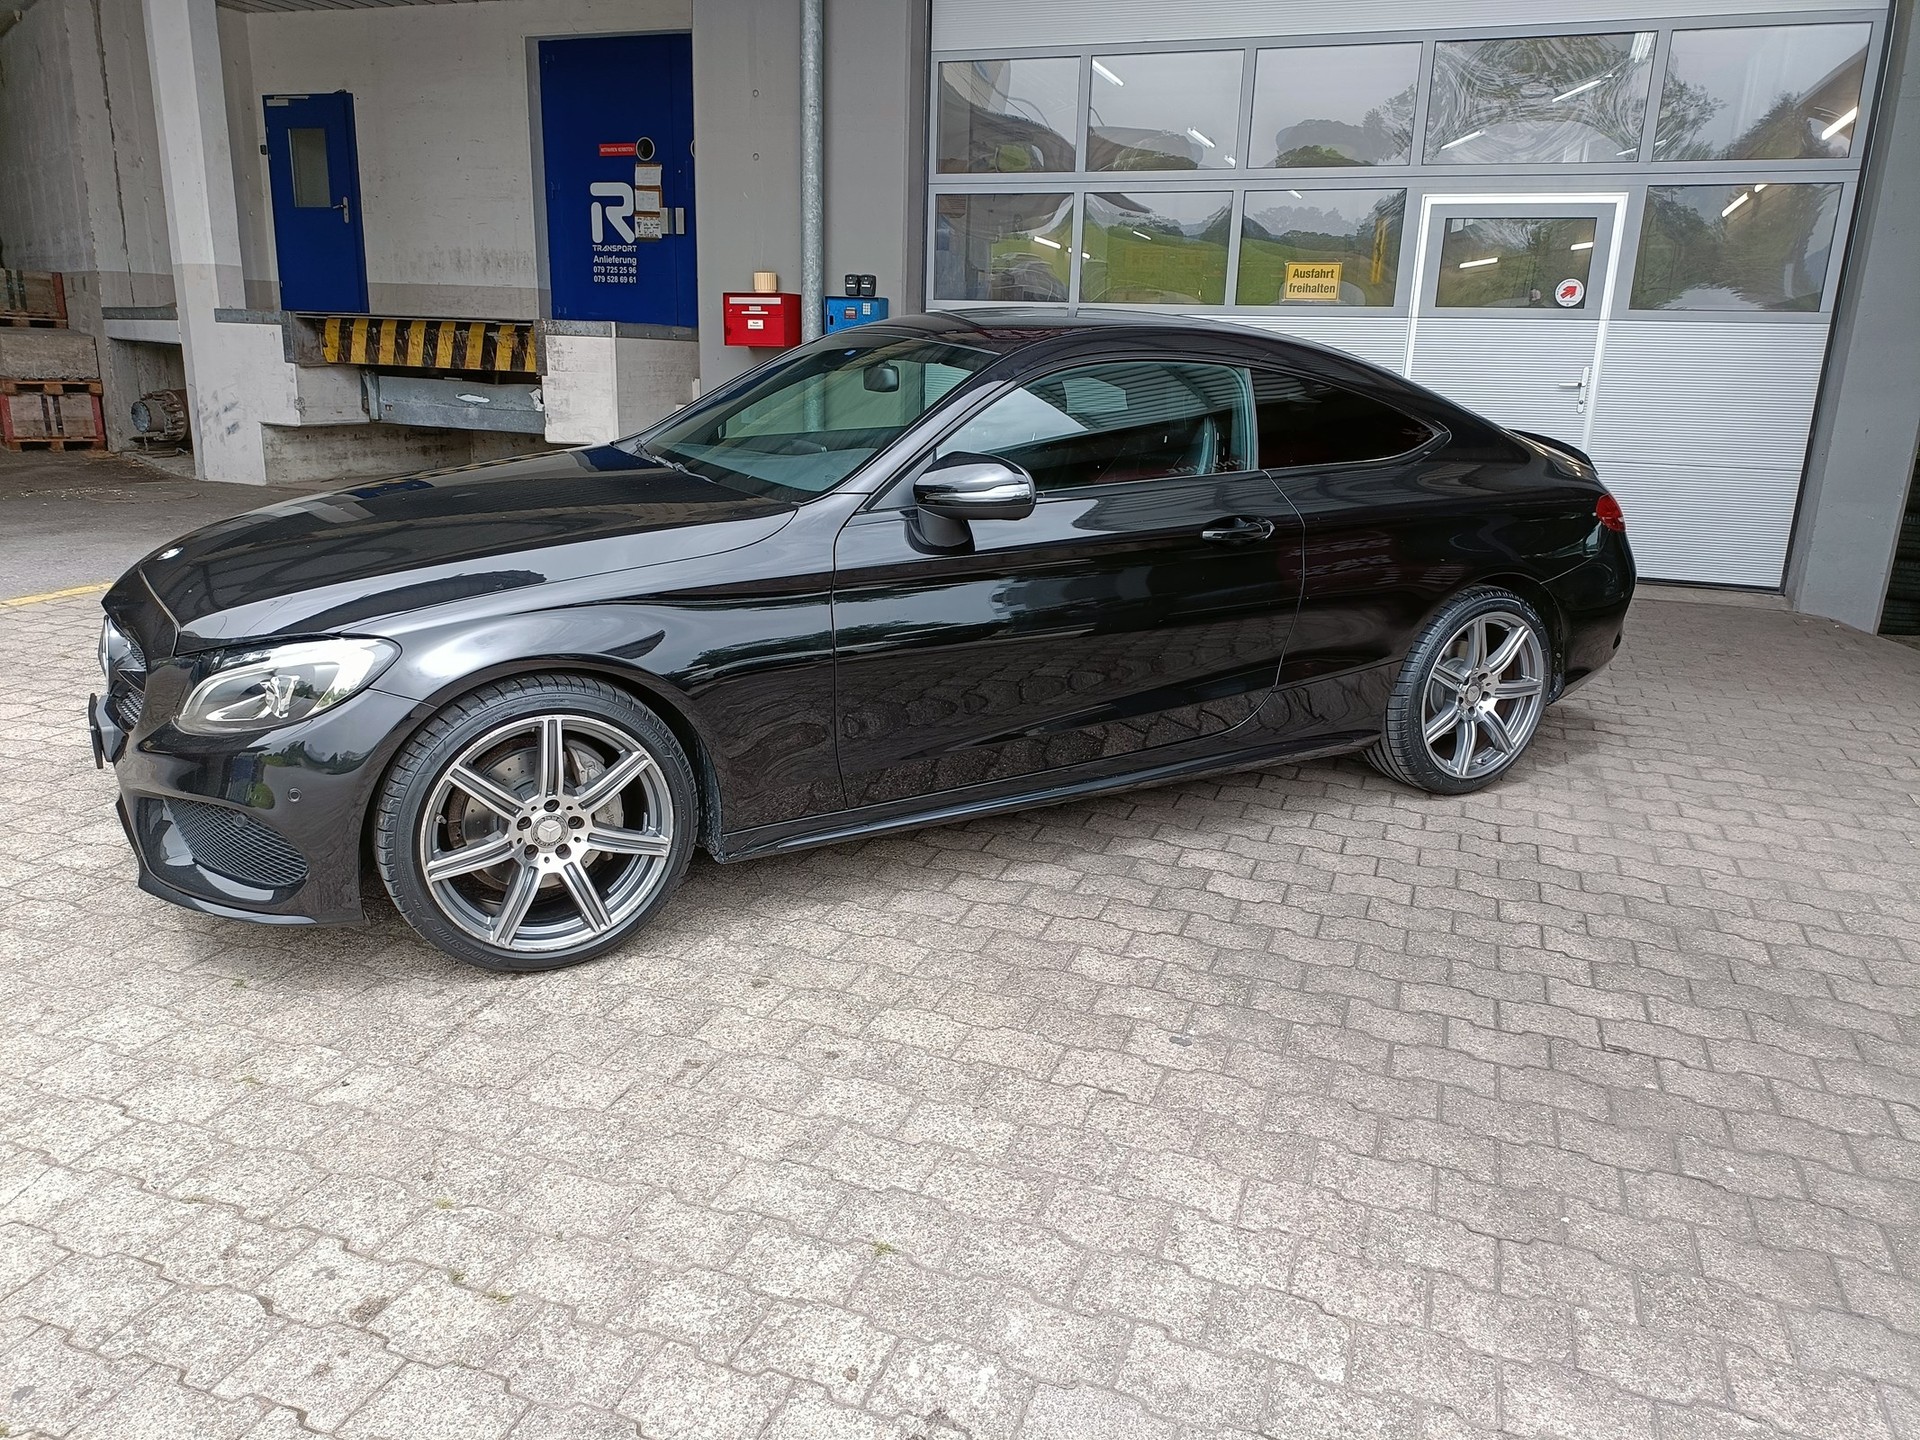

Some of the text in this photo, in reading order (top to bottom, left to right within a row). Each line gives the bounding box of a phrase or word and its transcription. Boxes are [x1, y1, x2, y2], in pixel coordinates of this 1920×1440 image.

[592, 244, 637, 252] TRANSPORT
[593, 255, 637, 266] Anlieferung
[593, 266, 637, 274] 079 725 25 96
[1293, 268, 1335, 278] Ausfahrt
[593, 275, 605, 283] 079
[606, 275, 618, 283] 528
[628, 276, 636, 284] 61
[1289, 283, 1335, 293] freihalten
